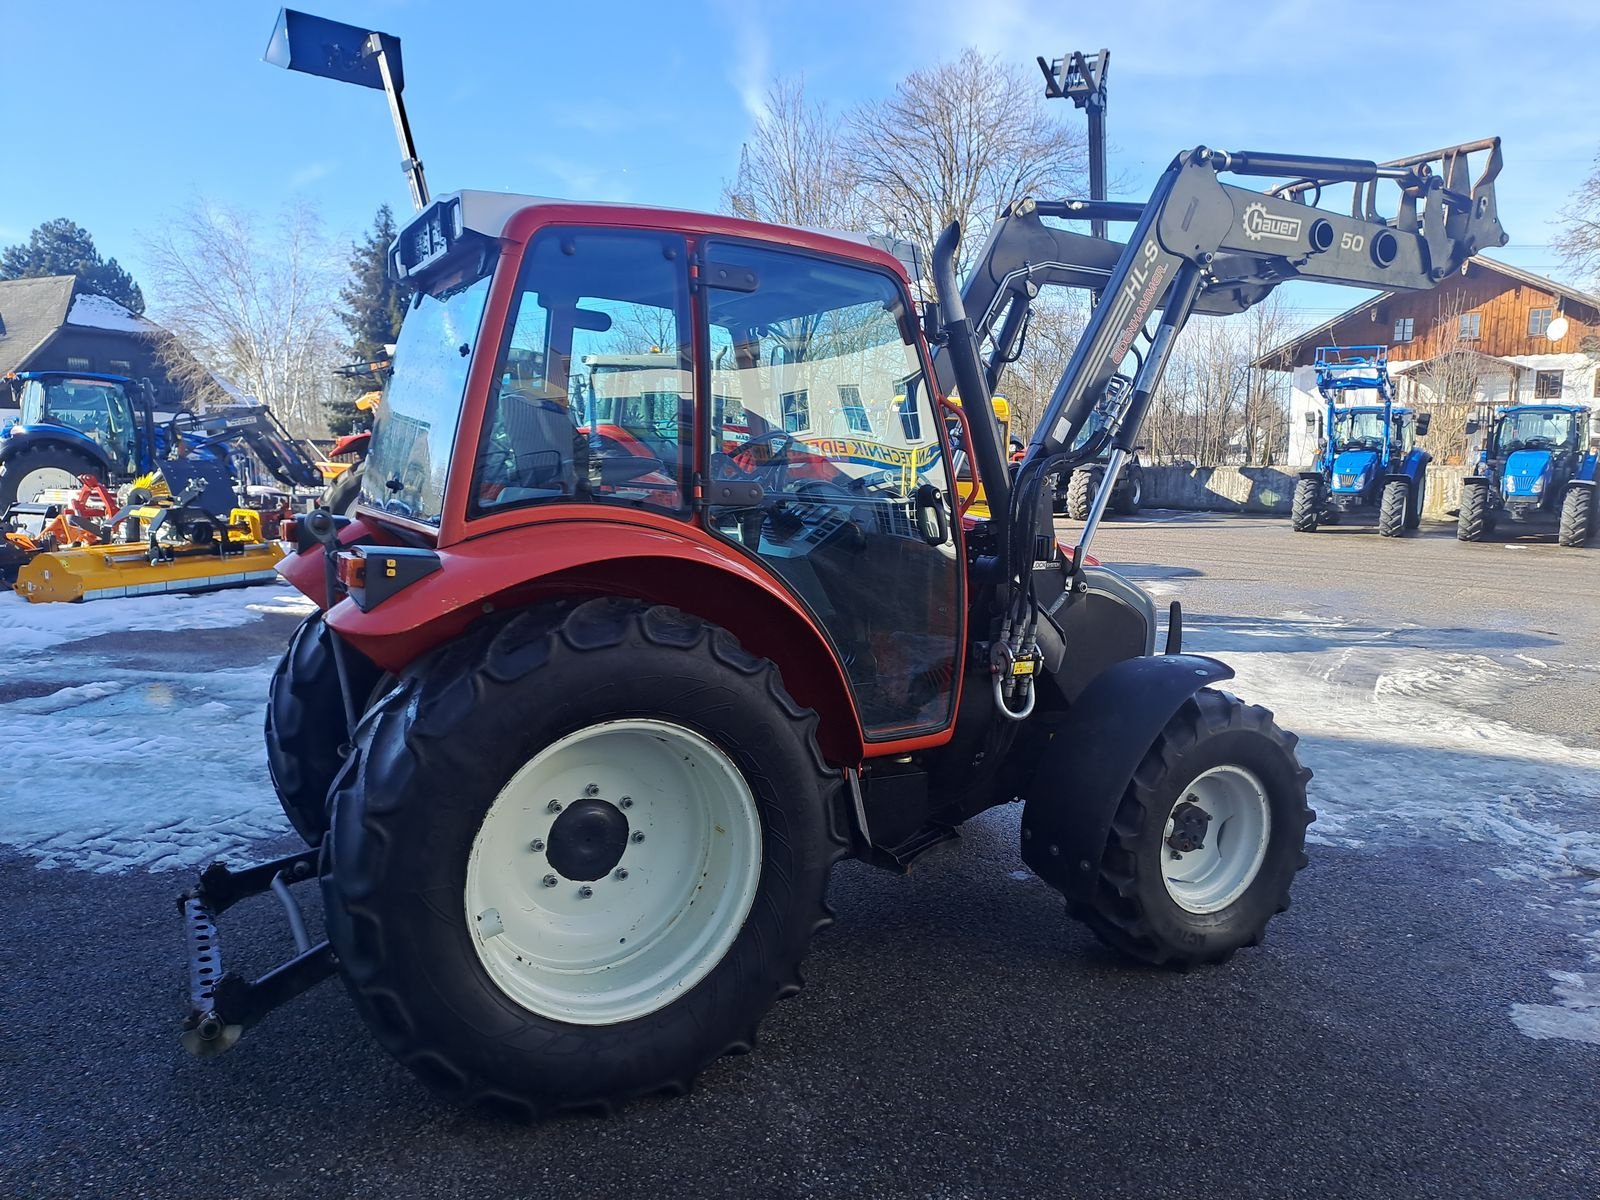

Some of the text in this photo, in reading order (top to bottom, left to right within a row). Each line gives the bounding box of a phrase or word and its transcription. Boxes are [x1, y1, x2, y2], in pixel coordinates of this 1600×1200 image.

[1250, 209, 1299, 238] hauer
[1341, 232, 1364, 252] 50
[1125, 239, 1158, 301] HL-S
